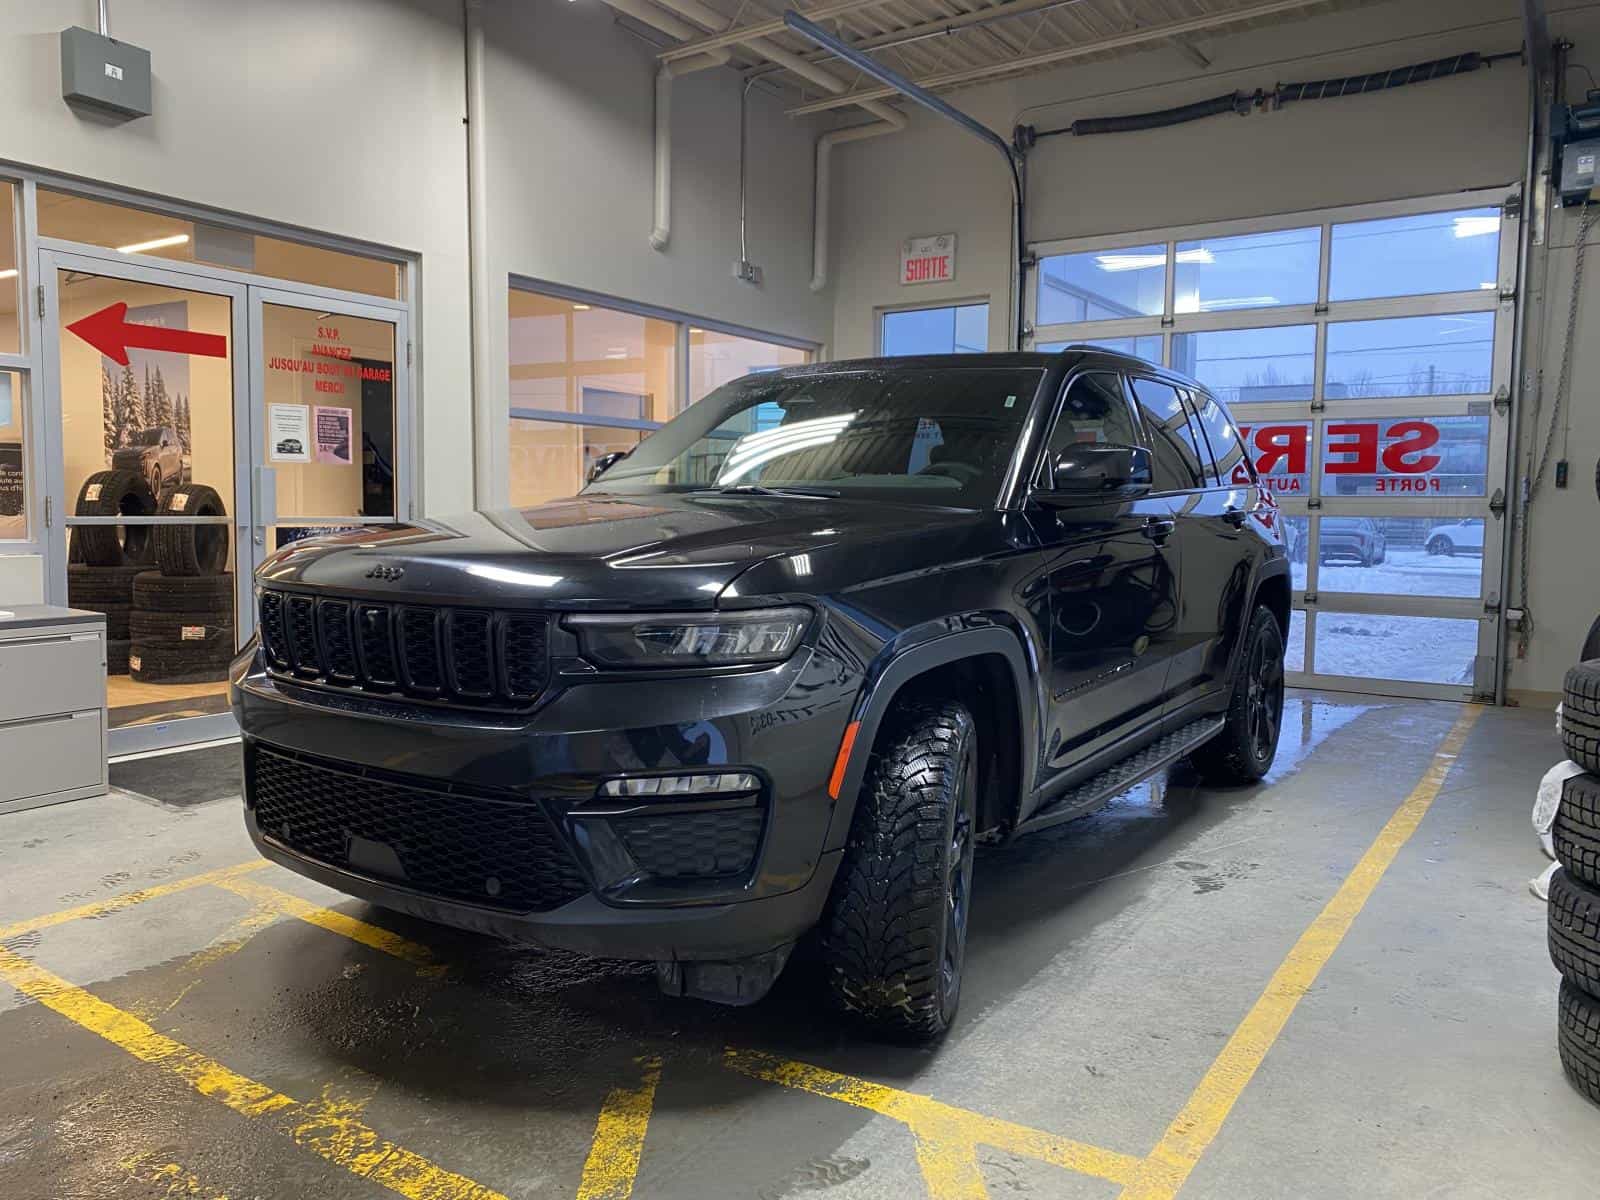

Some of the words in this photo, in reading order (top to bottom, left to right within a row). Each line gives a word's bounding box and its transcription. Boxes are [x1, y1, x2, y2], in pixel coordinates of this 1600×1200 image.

[906, 255, 950, 281] SORTIE
[317, 327, 341, 340] S.V.P.
[311, 344, 352, 360] AVANCEZ
[269, 357, 314, 373] JUSQU'AU
[357, 367, 391, 381] GARAGE
[365, 564, 404, 583] Jeep
